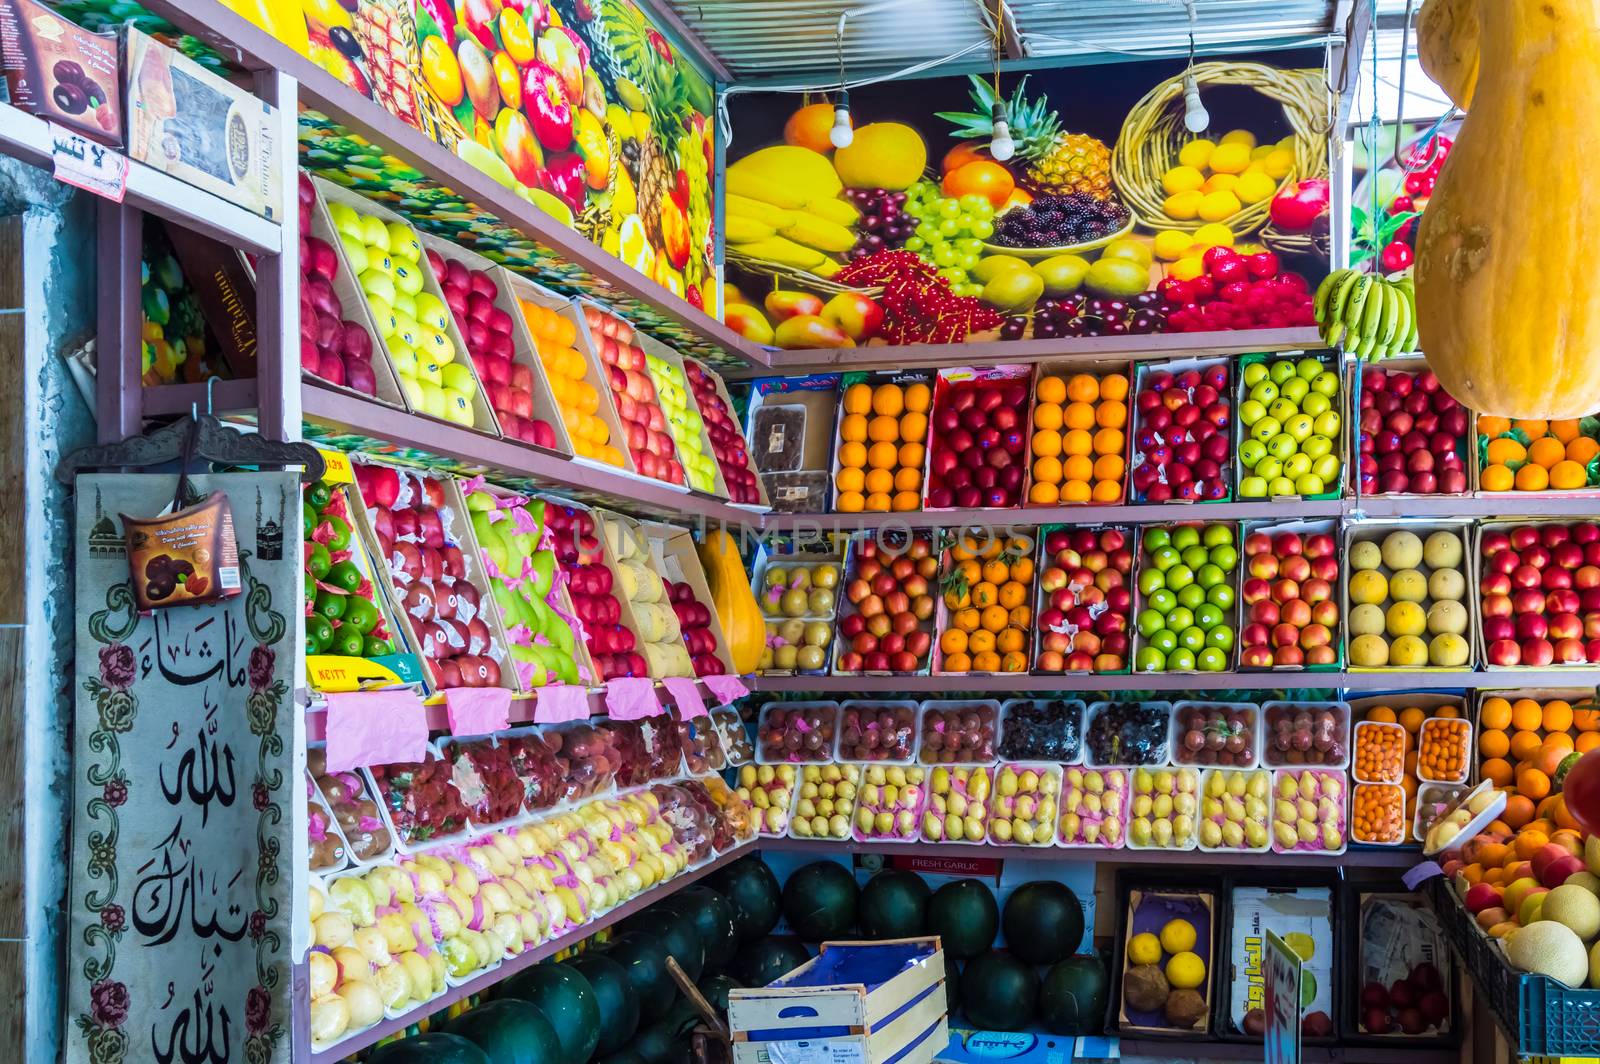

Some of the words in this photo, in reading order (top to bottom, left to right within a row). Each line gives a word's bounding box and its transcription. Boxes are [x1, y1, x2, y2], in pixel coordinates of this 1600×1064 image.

[318, 669, 346, 681] KEITT
[912, 858, 941, 868] FRESH
[943, 861, 979, 871] GARLIC
